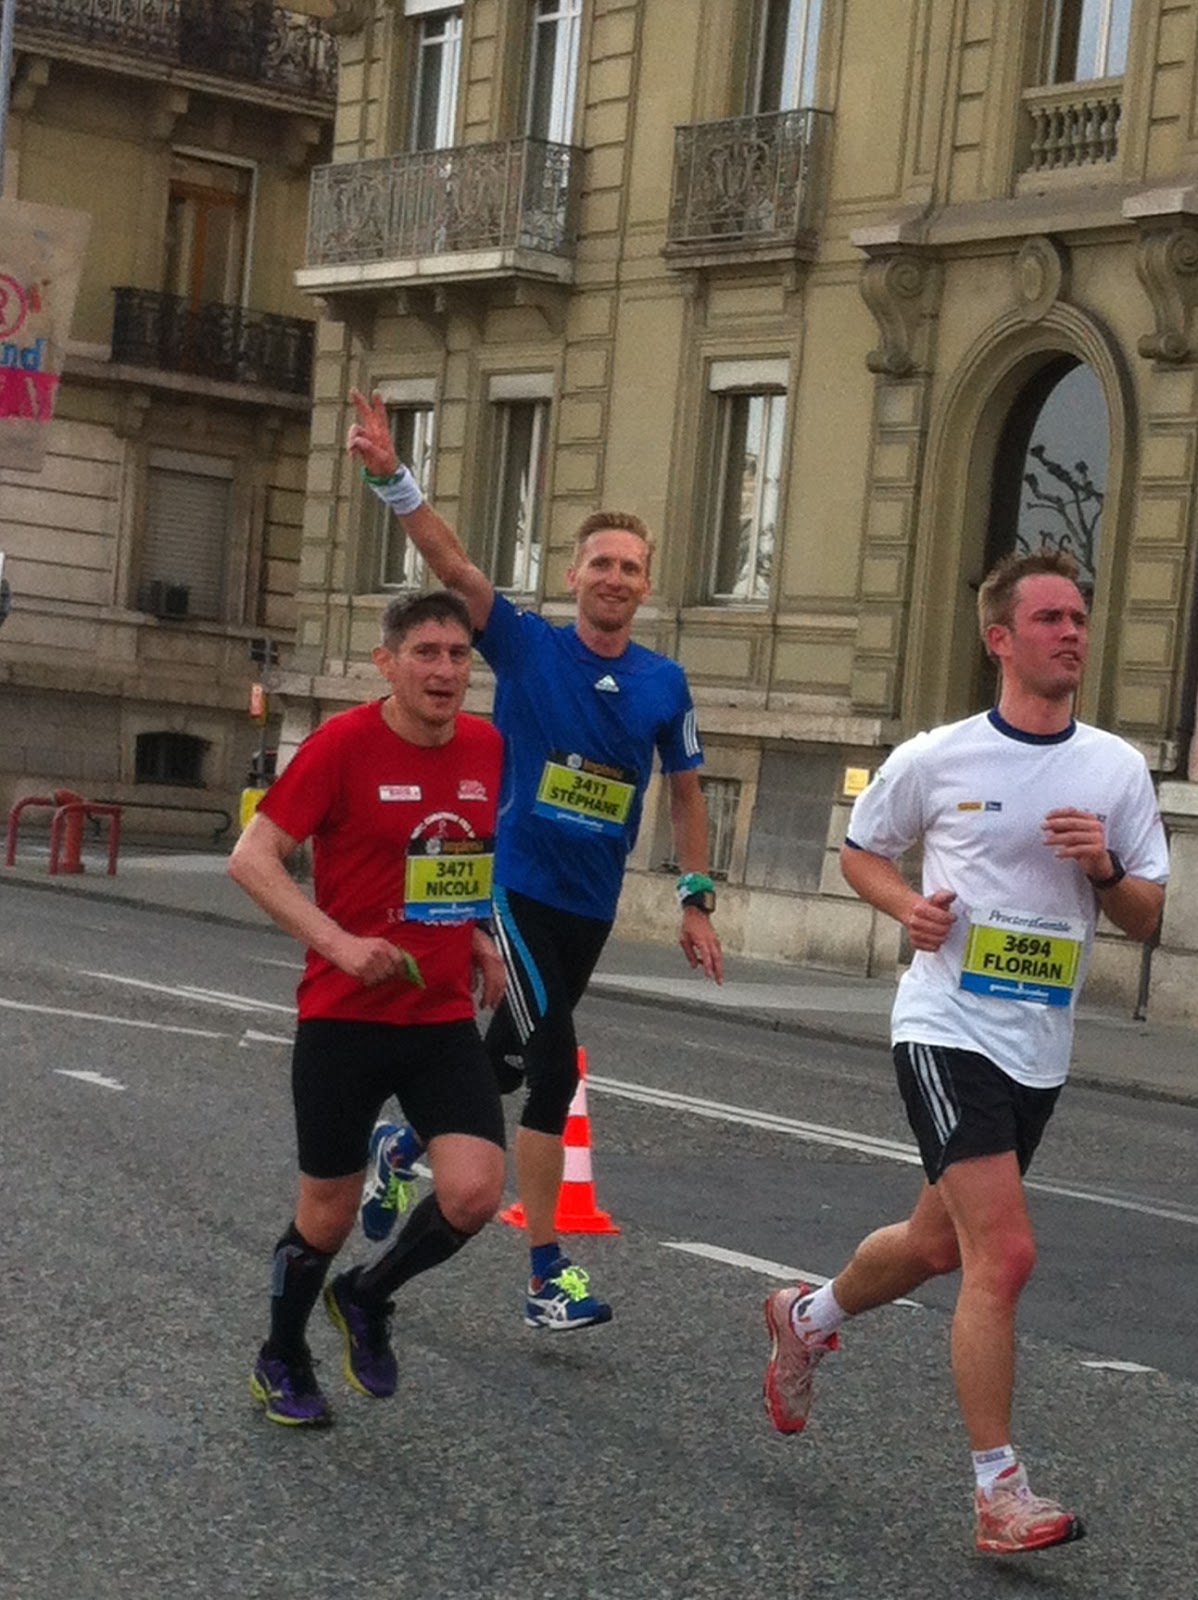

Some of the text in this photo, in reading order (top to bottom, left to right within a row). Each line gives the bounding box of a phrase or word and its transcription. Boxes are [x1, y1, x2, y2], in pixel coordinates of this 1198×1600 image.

[436, 862, 474, 877] 3471
[426, 881, 479, 896] NICOLA
[1003, 935, 1051, 958] 3694
[983, 953, 1062, 979] FLORIAN
